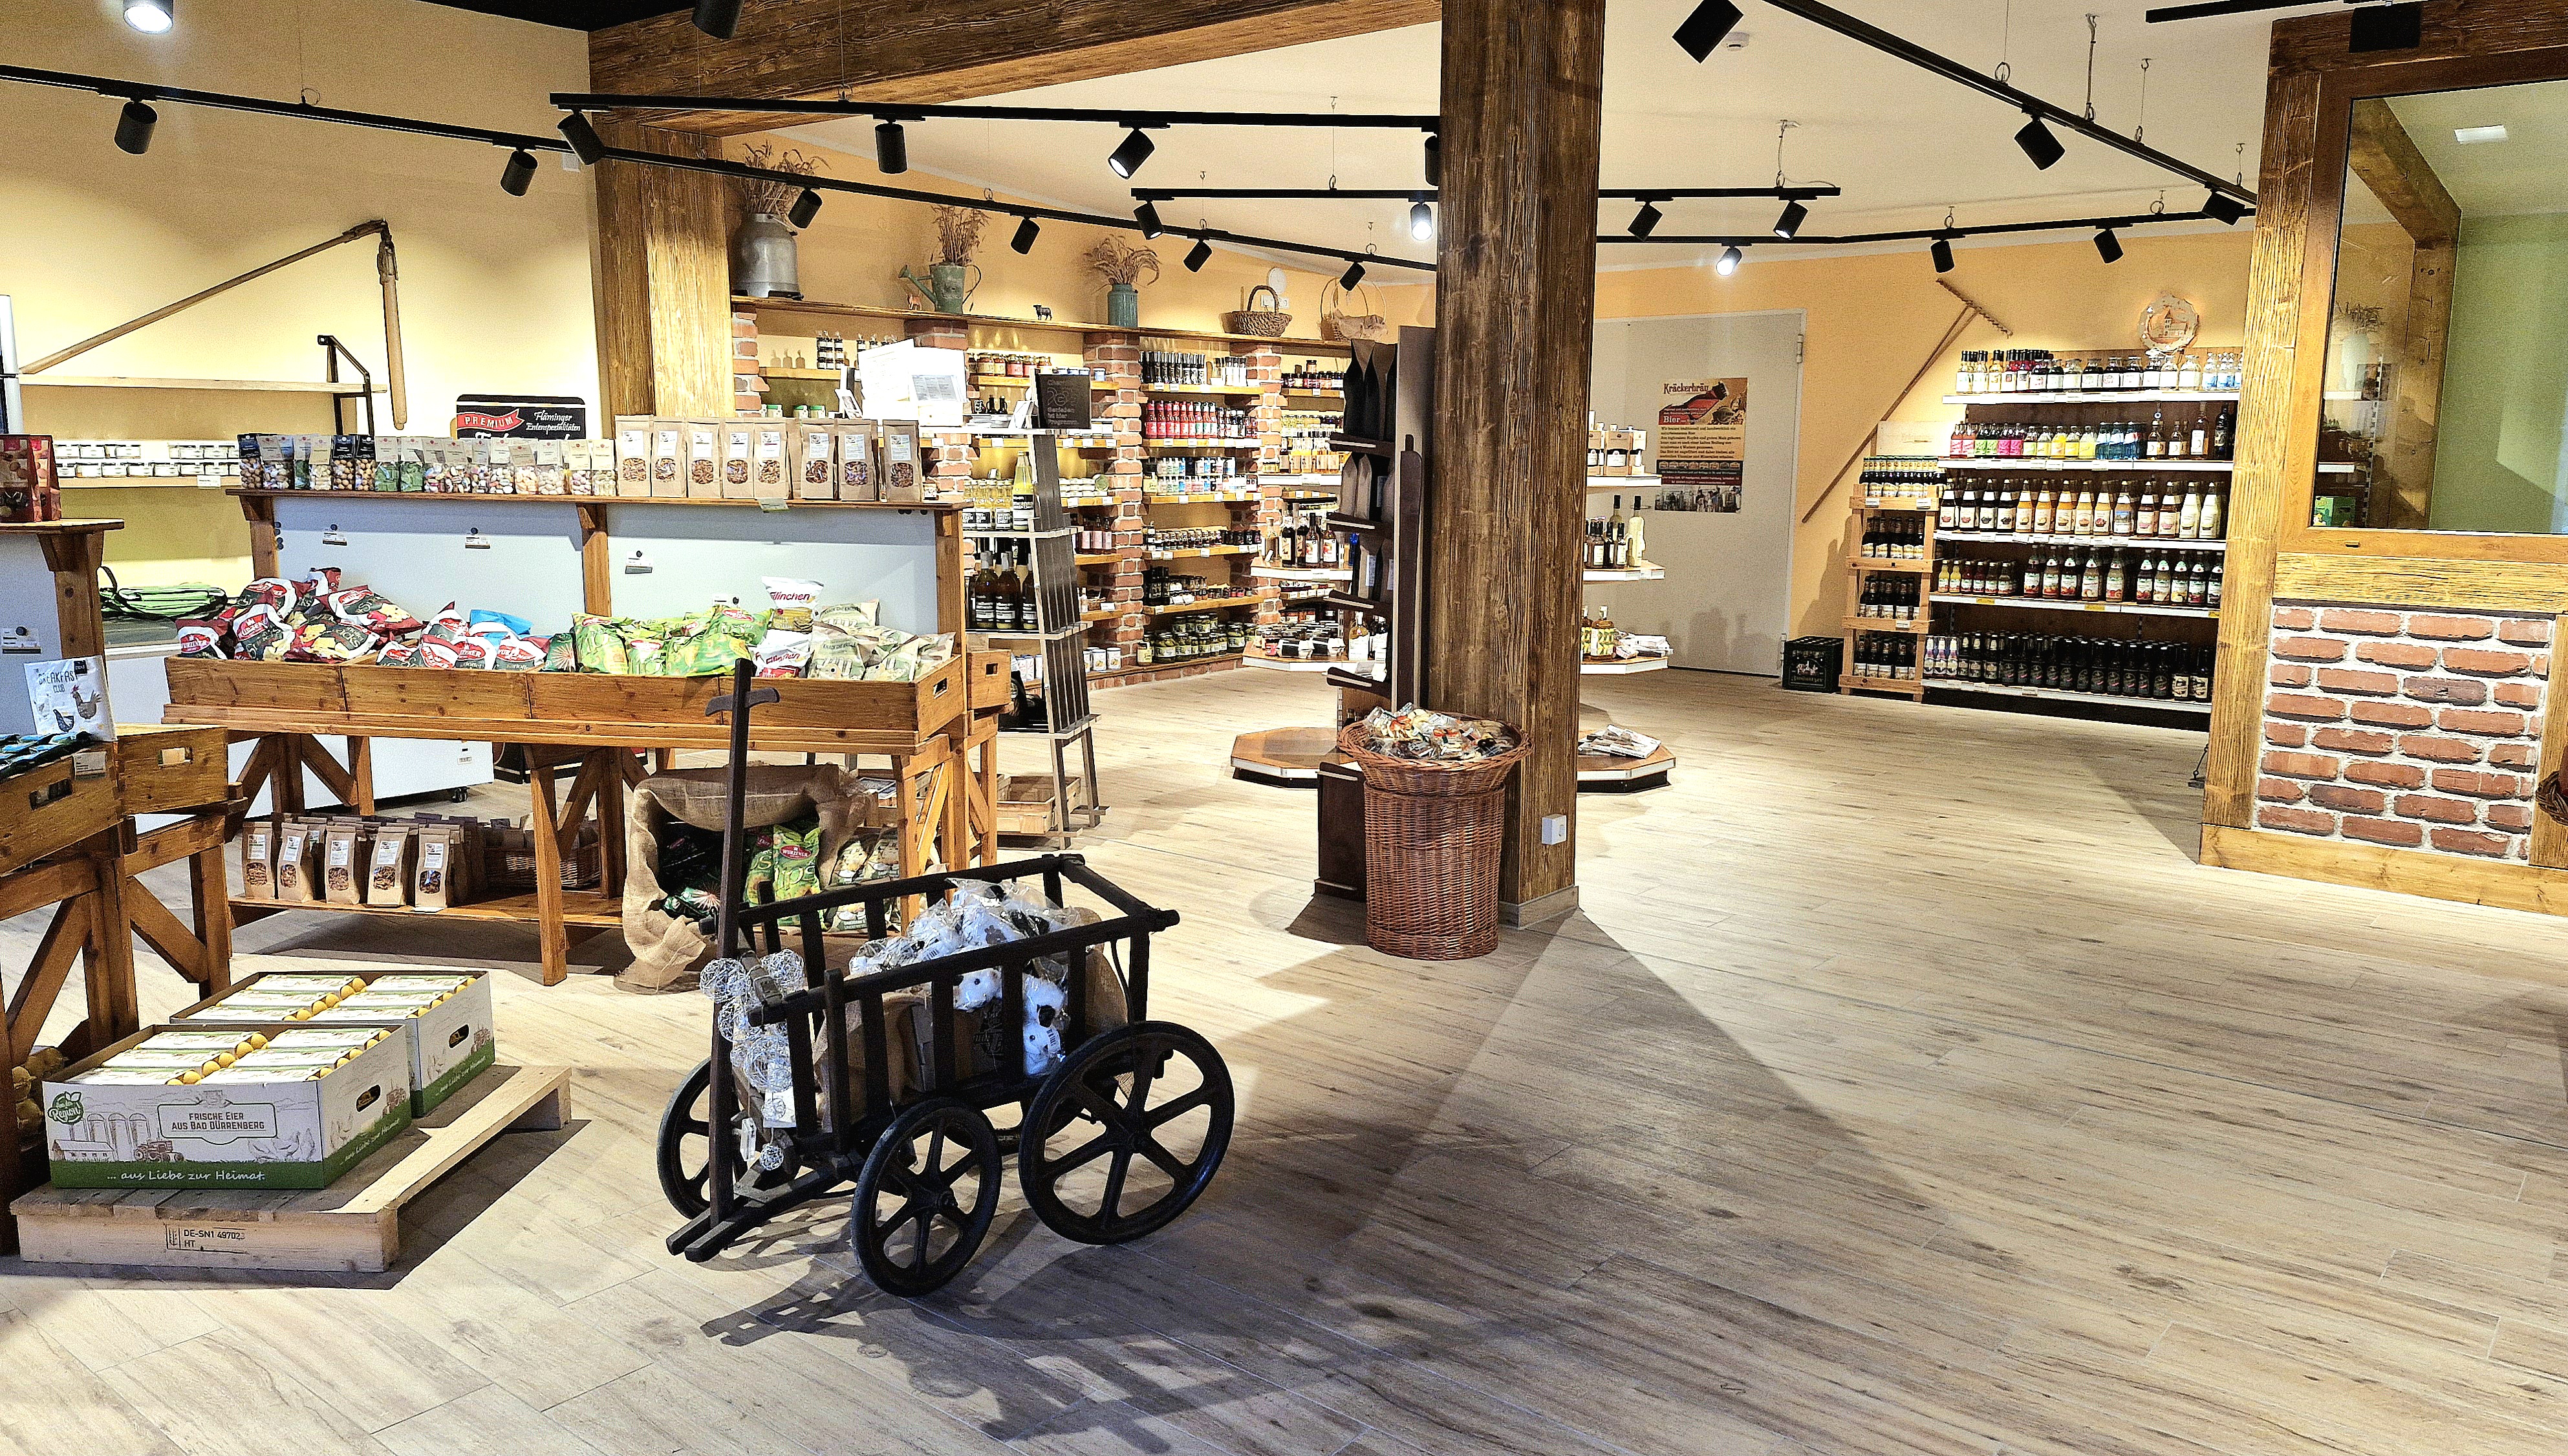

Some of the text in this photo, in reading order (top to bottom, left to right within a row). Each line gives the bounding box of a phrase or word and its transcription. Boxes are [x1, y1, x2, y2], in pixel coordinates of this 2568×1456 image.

[1663, 383, 1709, 394] Kräckerbräu
[464, 416, 513, 428] PREMIUM
[534, 409, 573, 425] Fläminger
[526, 422, 581, 434] Entenspezialitäten
[38, 670, 78, 685] BREAKFAST
[53, 684, 65, 693] CLUB
[171, 1120, 264, 1130] AUS BAD DÜRRENBERG
[120, 1172, 145, 1181] aus
[149, 1170, 185, 1181] Liebe
[188, 1172, 211, 1181] zur
[184, 1229, 214, 1238] DE-SN1
